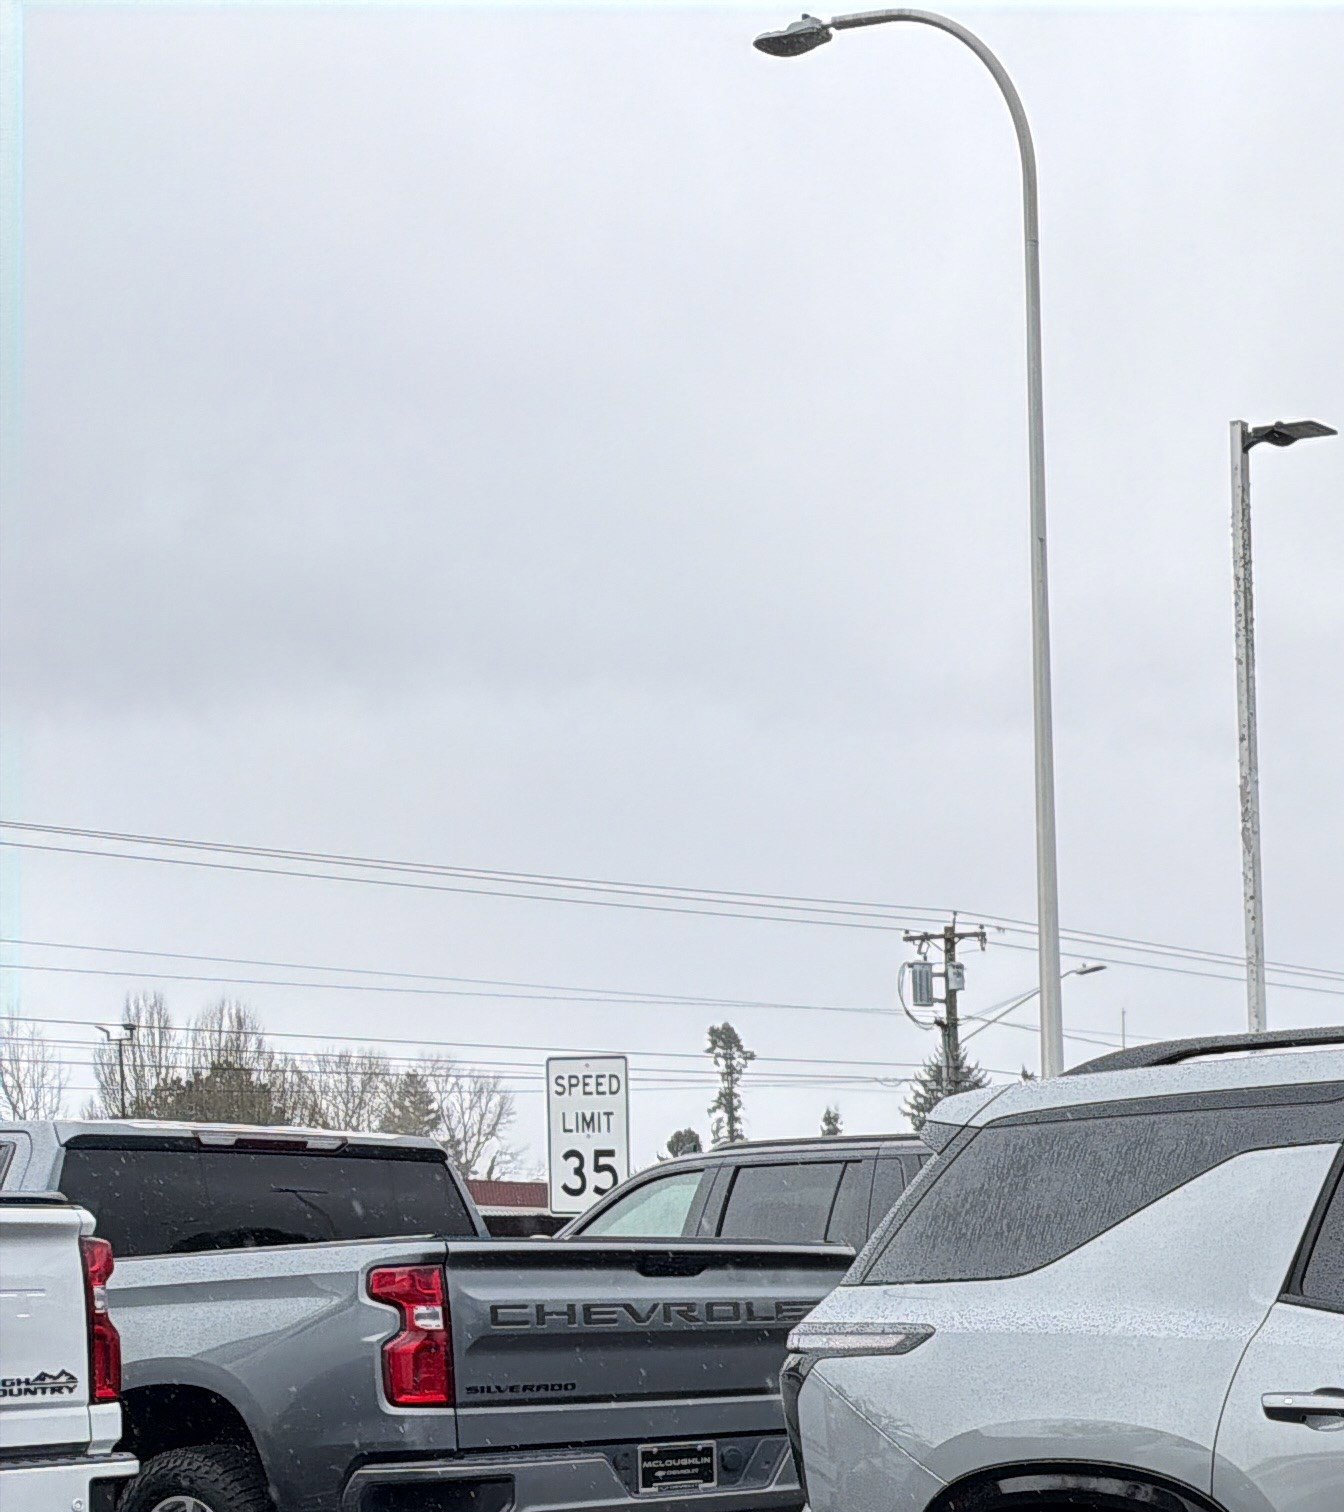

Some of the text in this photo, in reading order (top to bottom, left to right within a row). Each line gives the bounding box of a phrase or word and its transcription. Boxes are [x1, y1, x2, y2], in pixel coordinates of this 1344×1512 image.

[554, 1074, 621, 1096] SPEED
[561, 1111, 615, 1134] LIMIT
[560, 1149, 619, 1197] 35
[0, 1384, 78, 1397] OUNTRY
[465, 1382, 577, 1395] SILVERADO
